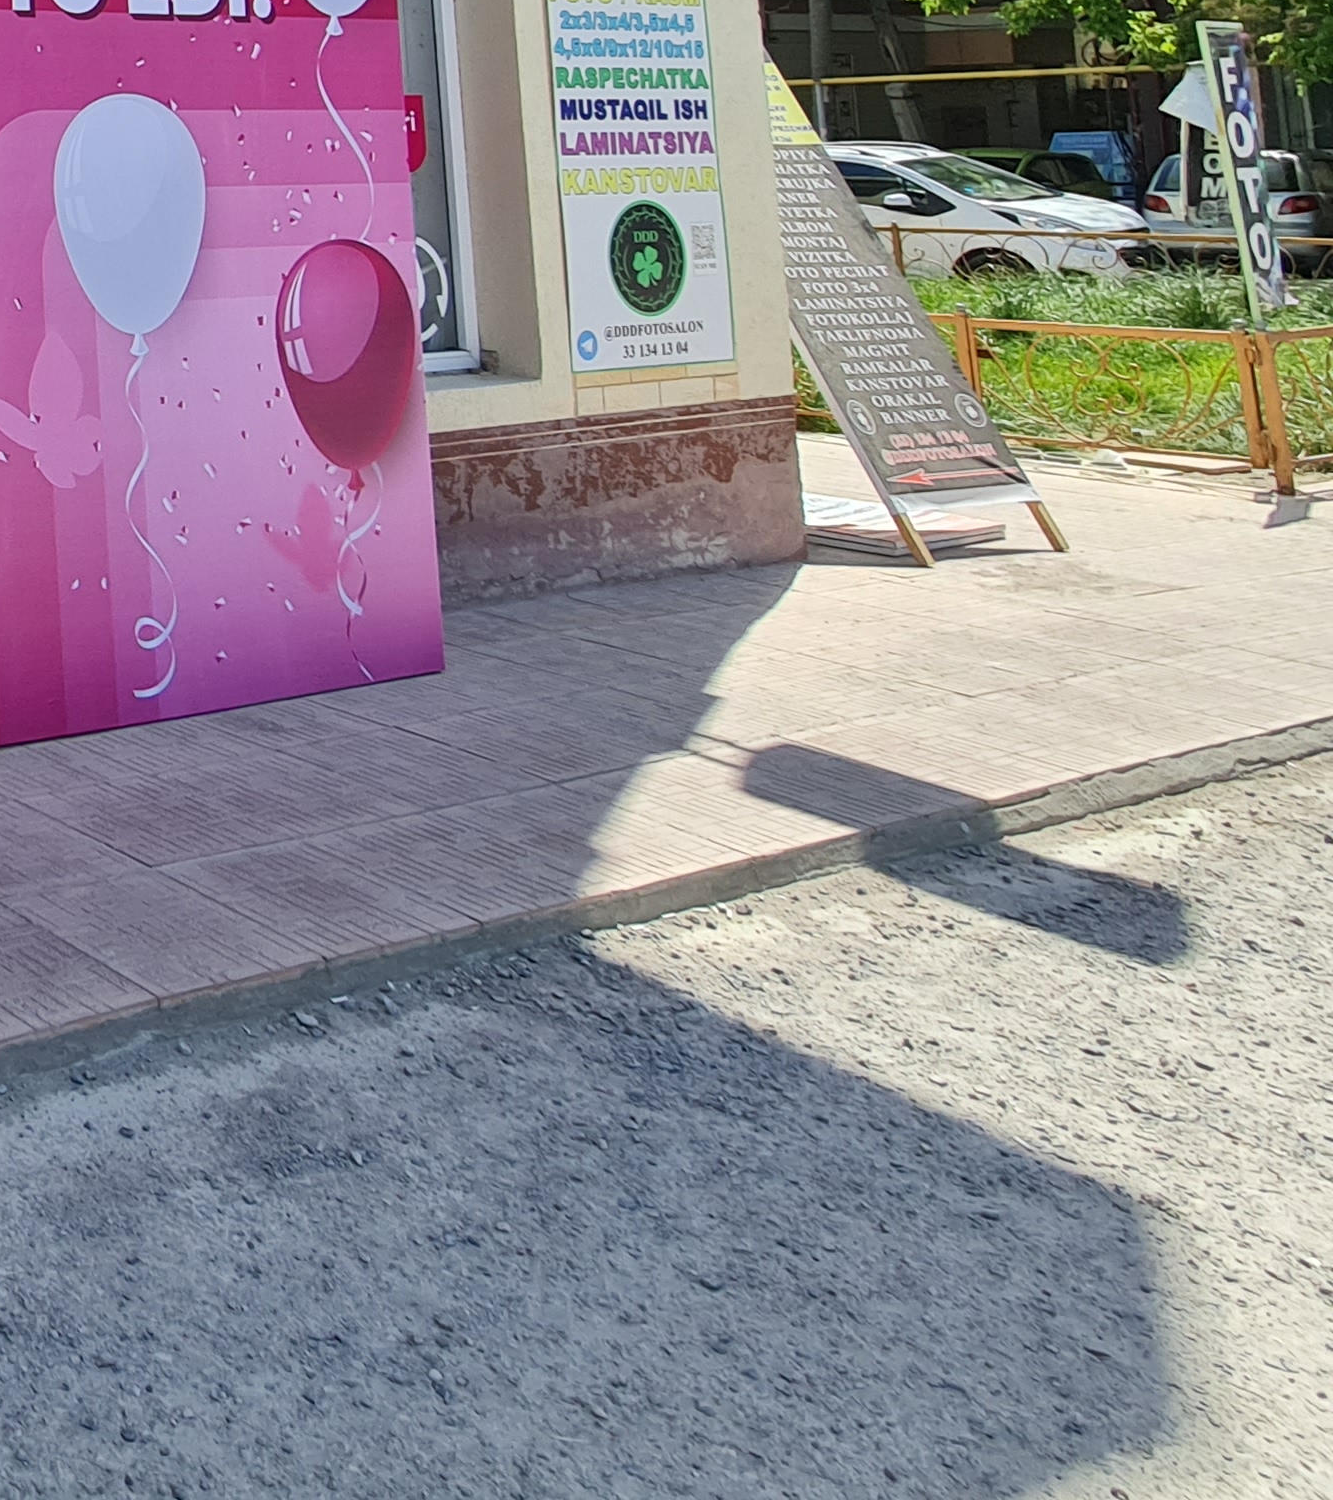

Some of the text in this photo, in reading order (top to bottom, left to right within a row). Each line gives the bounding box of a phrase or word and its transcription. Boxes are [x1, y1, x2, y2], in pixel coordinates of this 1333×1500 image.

[559, 10, 694, 36] 2x3/3x4/3,5x4,5
[554, 66, 710, 90] RASPECHATKA
[559, 98, 708, 122] MUSTAQIL ISH
[559, 131, 715, 156] LAMINATSIYA
[1218, 56, 1273, 270] FOTO
[561, 166, 720, 197] KANSTOVAR
[787, 250, 858, 264] VIZITKA
[783, 265, 890, 280] OTO PECHAT
[801, 281, 882, 295] FOTO 3x4
[792, 296, 910, 312] LAMINATSIYA
[804, 311, 917, 328] FOTOKOLLAJ
[603, 319, 705, 342] @DDDFOTOSALON
[811, 327, 927, 345] TAKLIFNOMA
[622, 340, 689, 359] 33 134 13 04
[841, 343, 912, 359] MAGNIT
[839, 358, 936, 376] RAMKALAR
[844, 374, 952, 392] KANSTOVAR
[870, 391, 943, 408] ORAKAL
[878, 407, 953, 426] BANNER
